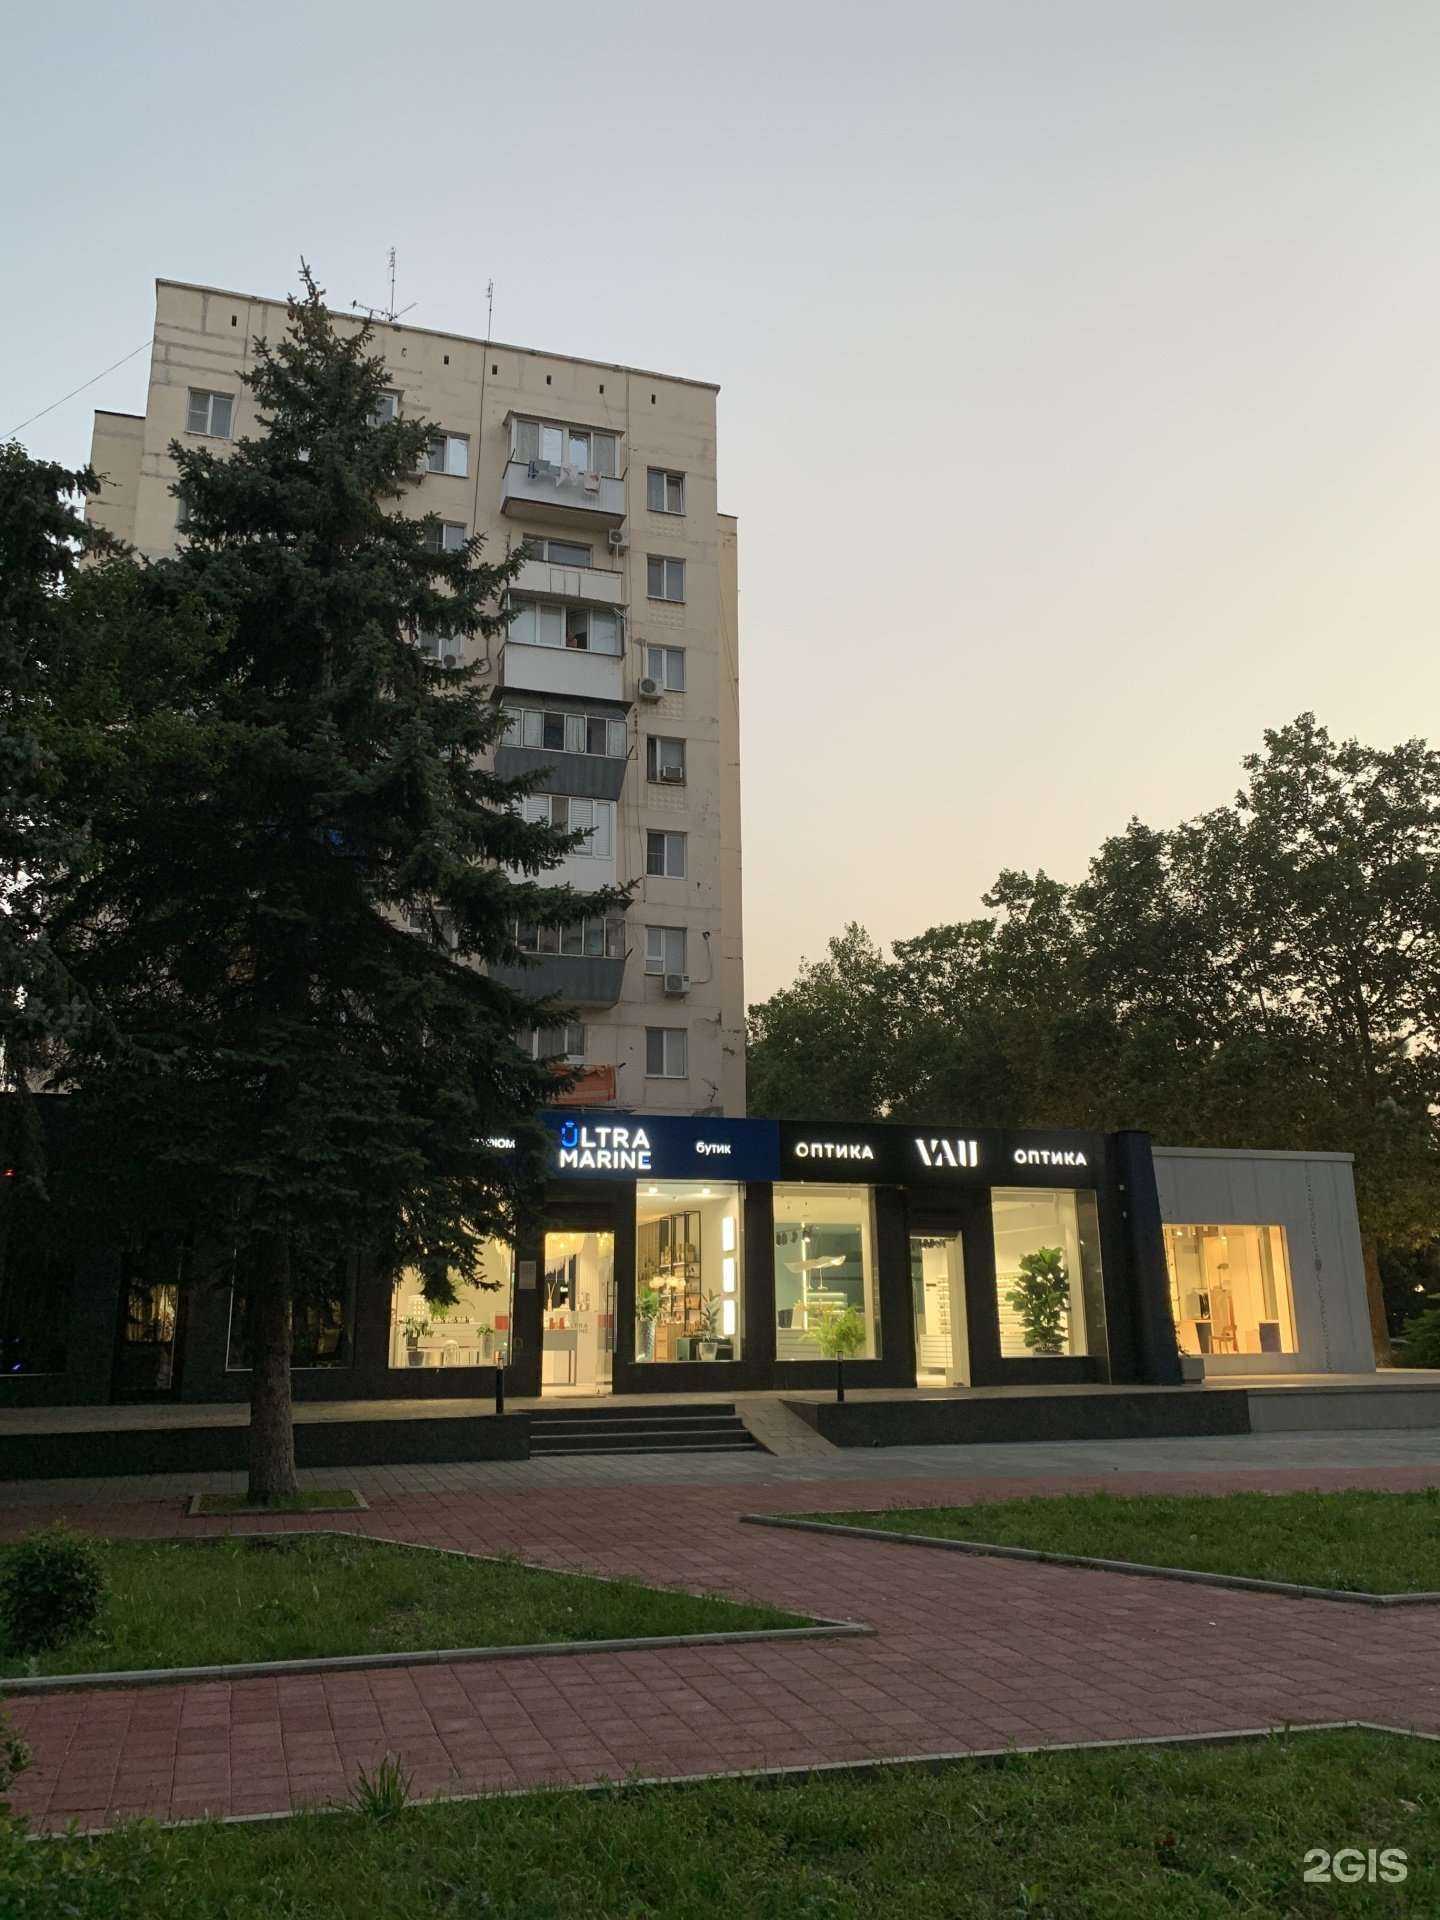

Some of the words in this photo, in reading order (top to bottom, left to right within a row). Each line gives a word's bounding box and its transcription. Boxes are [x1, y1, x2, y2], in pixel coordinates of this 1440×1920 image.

[560, 1121, 650, 1149] ULTRA
[696, 1141, 731, 1156] бутик
[795, 1142, 874, 1160] ОПТИКА
[1014, 1149, 1087, 1166] ОПТИКА
[559, 1149, 651, 1169] MARINE
